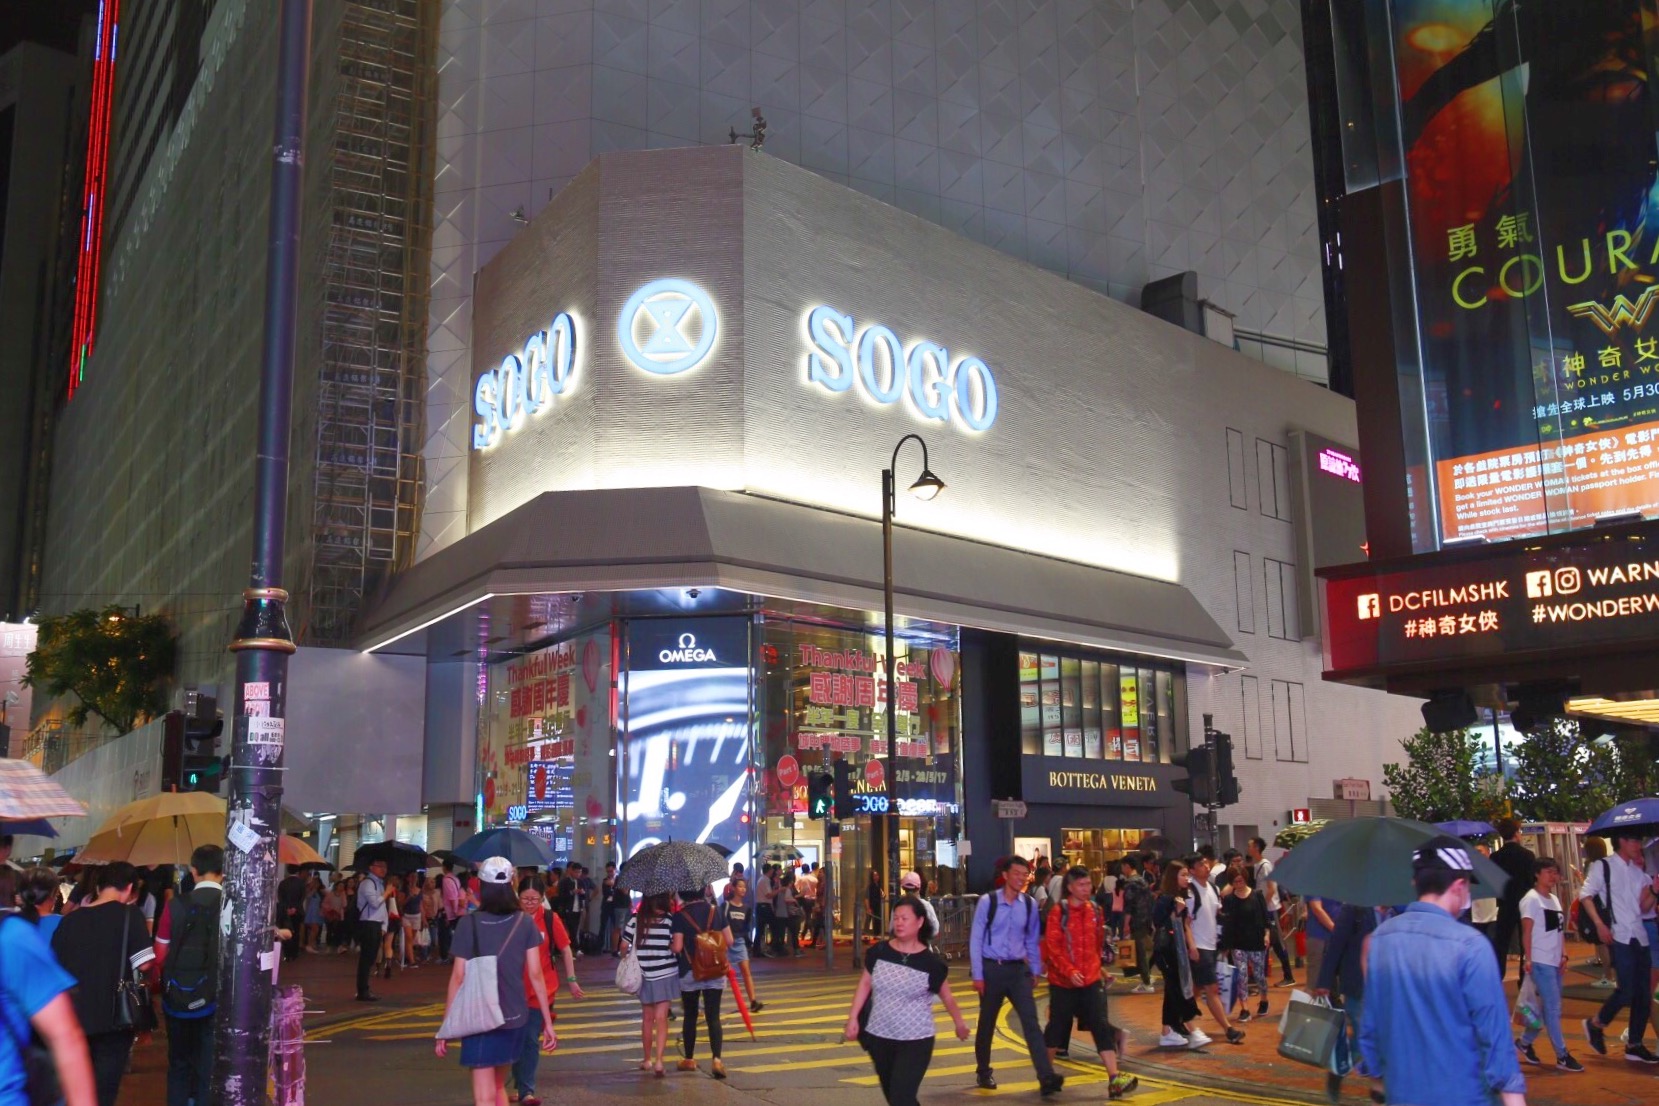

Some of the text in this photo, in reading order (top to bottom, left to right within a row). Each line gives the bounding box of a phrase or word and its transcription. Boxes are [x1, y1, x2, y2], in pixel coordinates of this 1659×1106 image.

[1448, 211, 1534, 261] 勇氣
[474, 312, 577, 450] SOGO
[808, 305, 998, 431] SOGO
[1564, 369, 1631, 391] WONDER
[1455, 492, 1475, 502] Book
[1476, 489, 1494, 500] your
[1495, 482, 1534, 495] WONDER
[1571, 471, 1598, 483] tickets
[1600, 469, 1609, 477] at
[1611, 467, 1625, 476] the
[1626, 464, 1642, 473] box
[1456, 503, 1469, 512] get
[1476, 496, 1503, 508] limited
[1504, 490, 1543, 503] WONDER
[1580, 479, 1618, 493] passport
[1619, 473, 1647, 485] holder.
[1456, 504, 1519, 520] While stock last.
[1389, 580, 1509, 612] DCFILMSHK
[1404, 609, 1499, 638] #神奇女俠
[507, 645, 576, 685] Thankful Week
[659, 648, 717, 663] OMEGA
[799, 644, 877, 673] Thankful
[245, 685, 268, 697] ABOVE
[1049, 770, 1156, 791] BOTTEGA VENETA
[509, 805, 527, 821] SOGO
